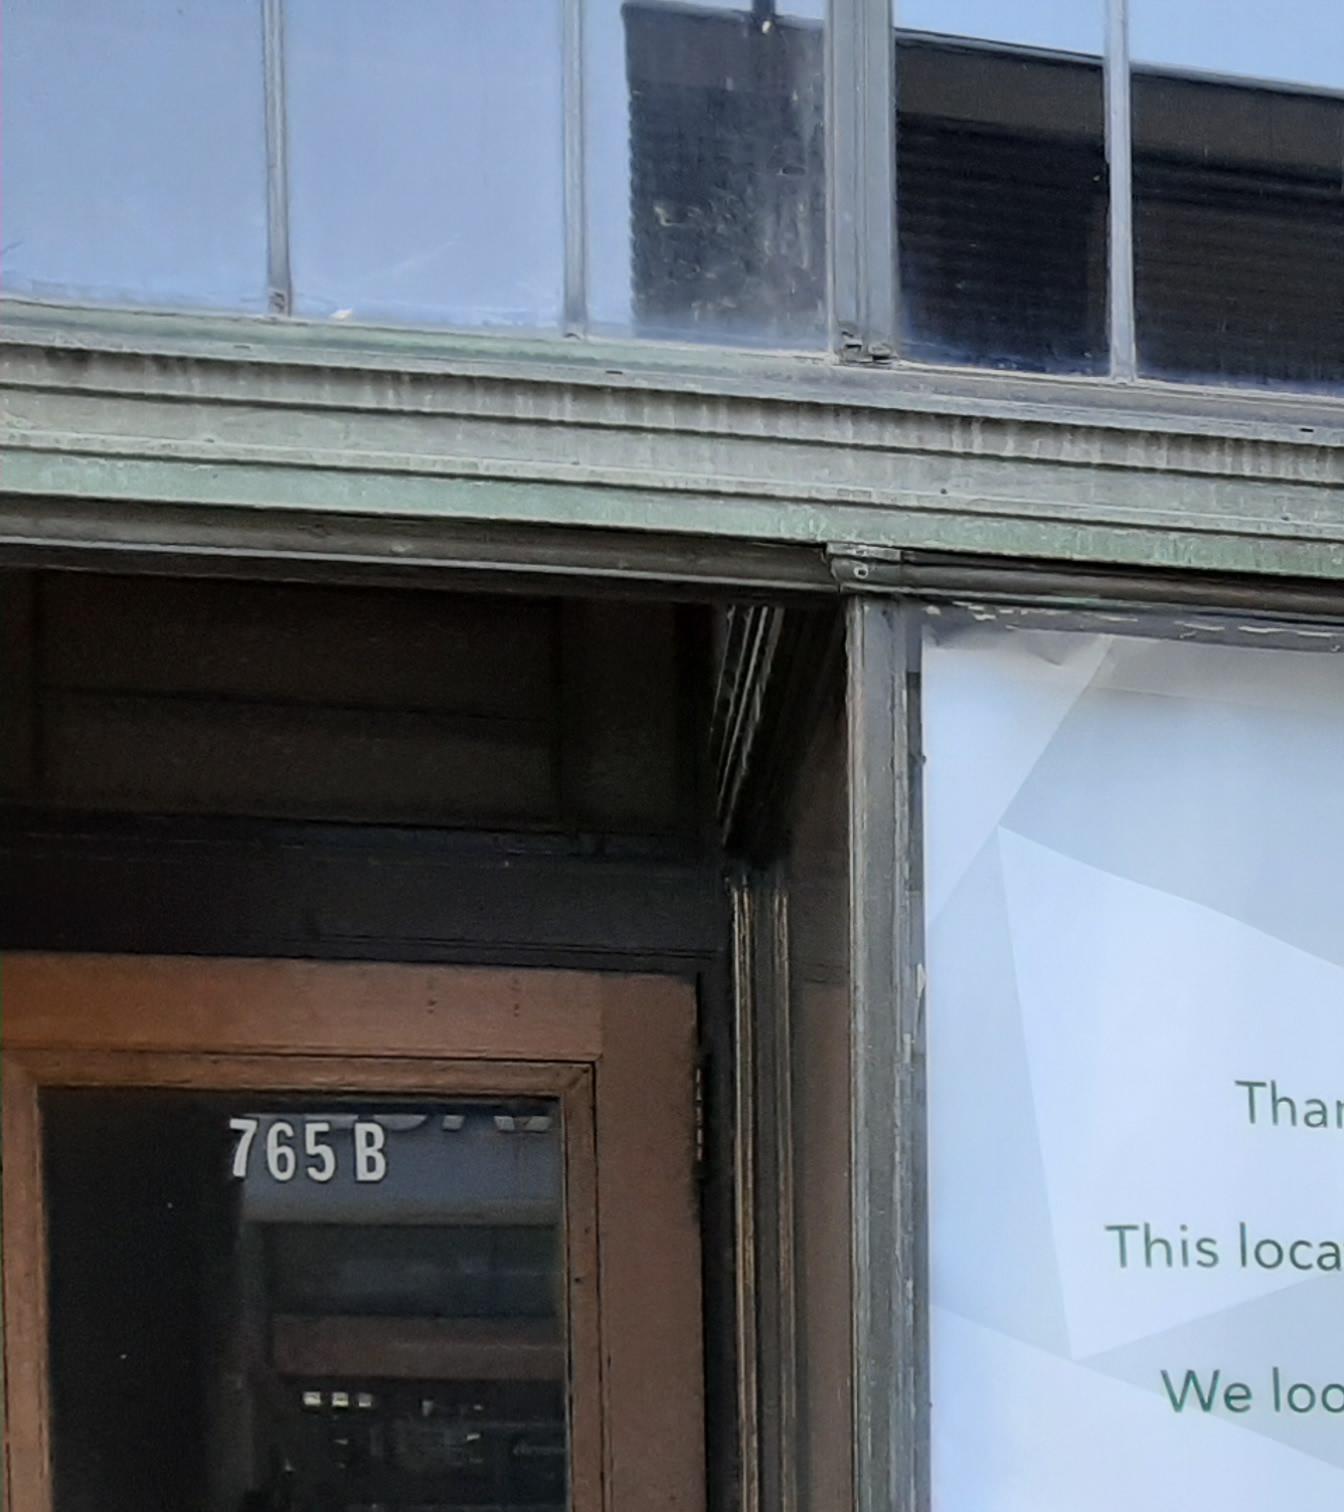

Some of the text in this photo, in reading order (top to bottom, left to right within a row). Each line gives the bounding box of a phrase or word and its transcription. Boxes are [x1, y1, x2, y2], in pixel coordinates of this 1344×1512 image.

[229, 1118, 387, 1183] 765 B
[1106, 1223, 1218, 1268] This
[1161, 1370, 1251, 1412] We
